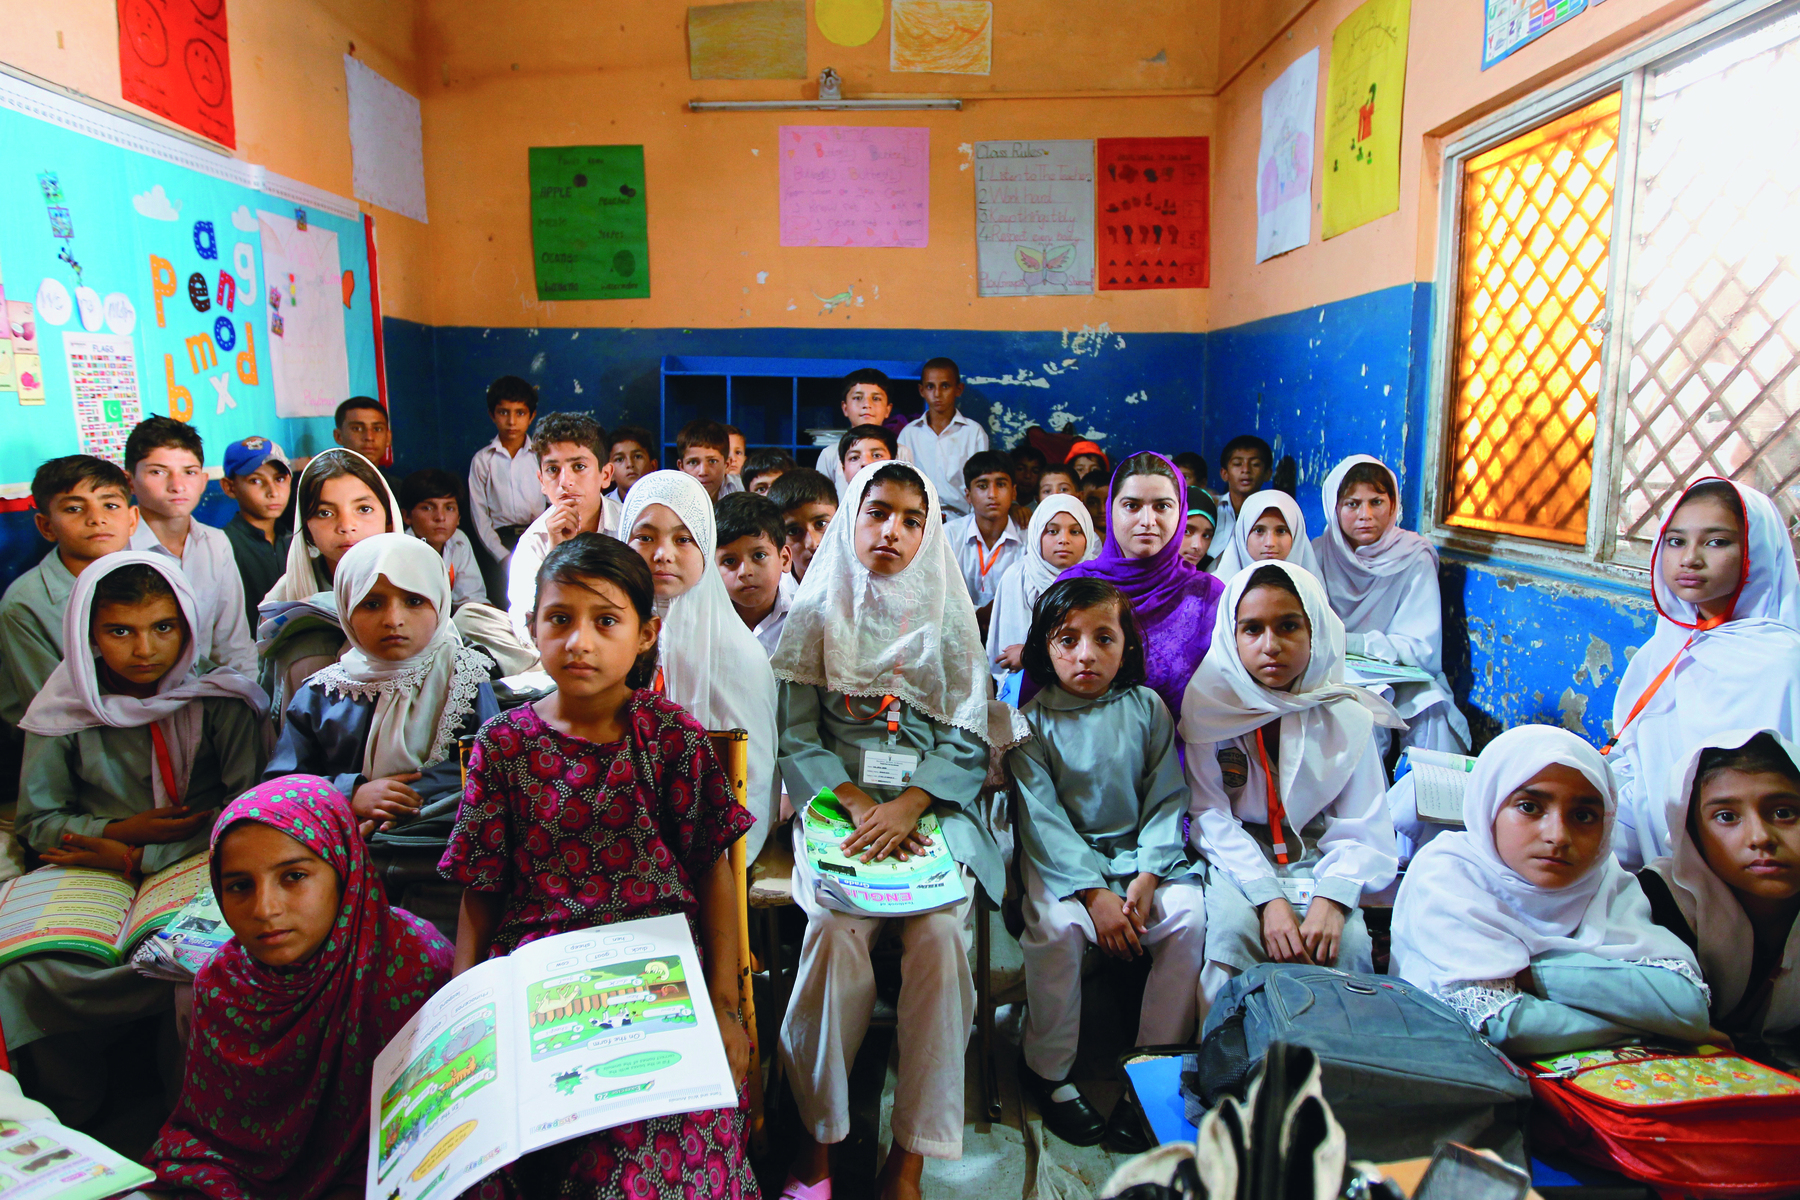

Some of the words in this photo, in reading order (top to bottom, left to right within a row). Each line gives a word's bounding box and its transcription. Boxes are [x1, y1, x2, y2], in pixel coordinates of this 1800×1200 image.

[1489, 5, 1498, 20] U
[976, 144, 1010, 159] Class
[1013, 142, 1042, 158] Rules
[990, 165, 1023, 181] Listen
[1024, 166, 1037, 181] to
[540, 186, 574, 199] APPLE
[991, 185, 1020, 204] Work
[1024, 183, 1052, 204] hard
[1052, 206, 1077, 233] tidy
[193, 220, 218, 260] a
[992, 224, 1027, 246] Respect
[233, 241, 258, 306] g
[149, 254, 178, 328] p
[188, 272, 211, 312] e
[216, 268, 236, 312] n
[92, 344, 115, 353] FLAGS
[184, 333, 218, 375] m
[236, 322, 258, 386] d
[164, 353, 194, 423] b
[844, 880, 870, 889] Grade
[188, 936, 212, 948] Grade
[570, 942, 591, 950] sheep
[594, 952, 610, 960] goat
[440, 990, 461, 1010] leopard
[455, 991, 489, 1014] rhinoceros
[420, 1021, 442, 1044] elephant
[596, 1092, 609, 1100] 26
[611, 1086, 640, 1095] Exercise
[440, 1110, 450, 1121] the
[422, 1118, 440, 1138] jungle
